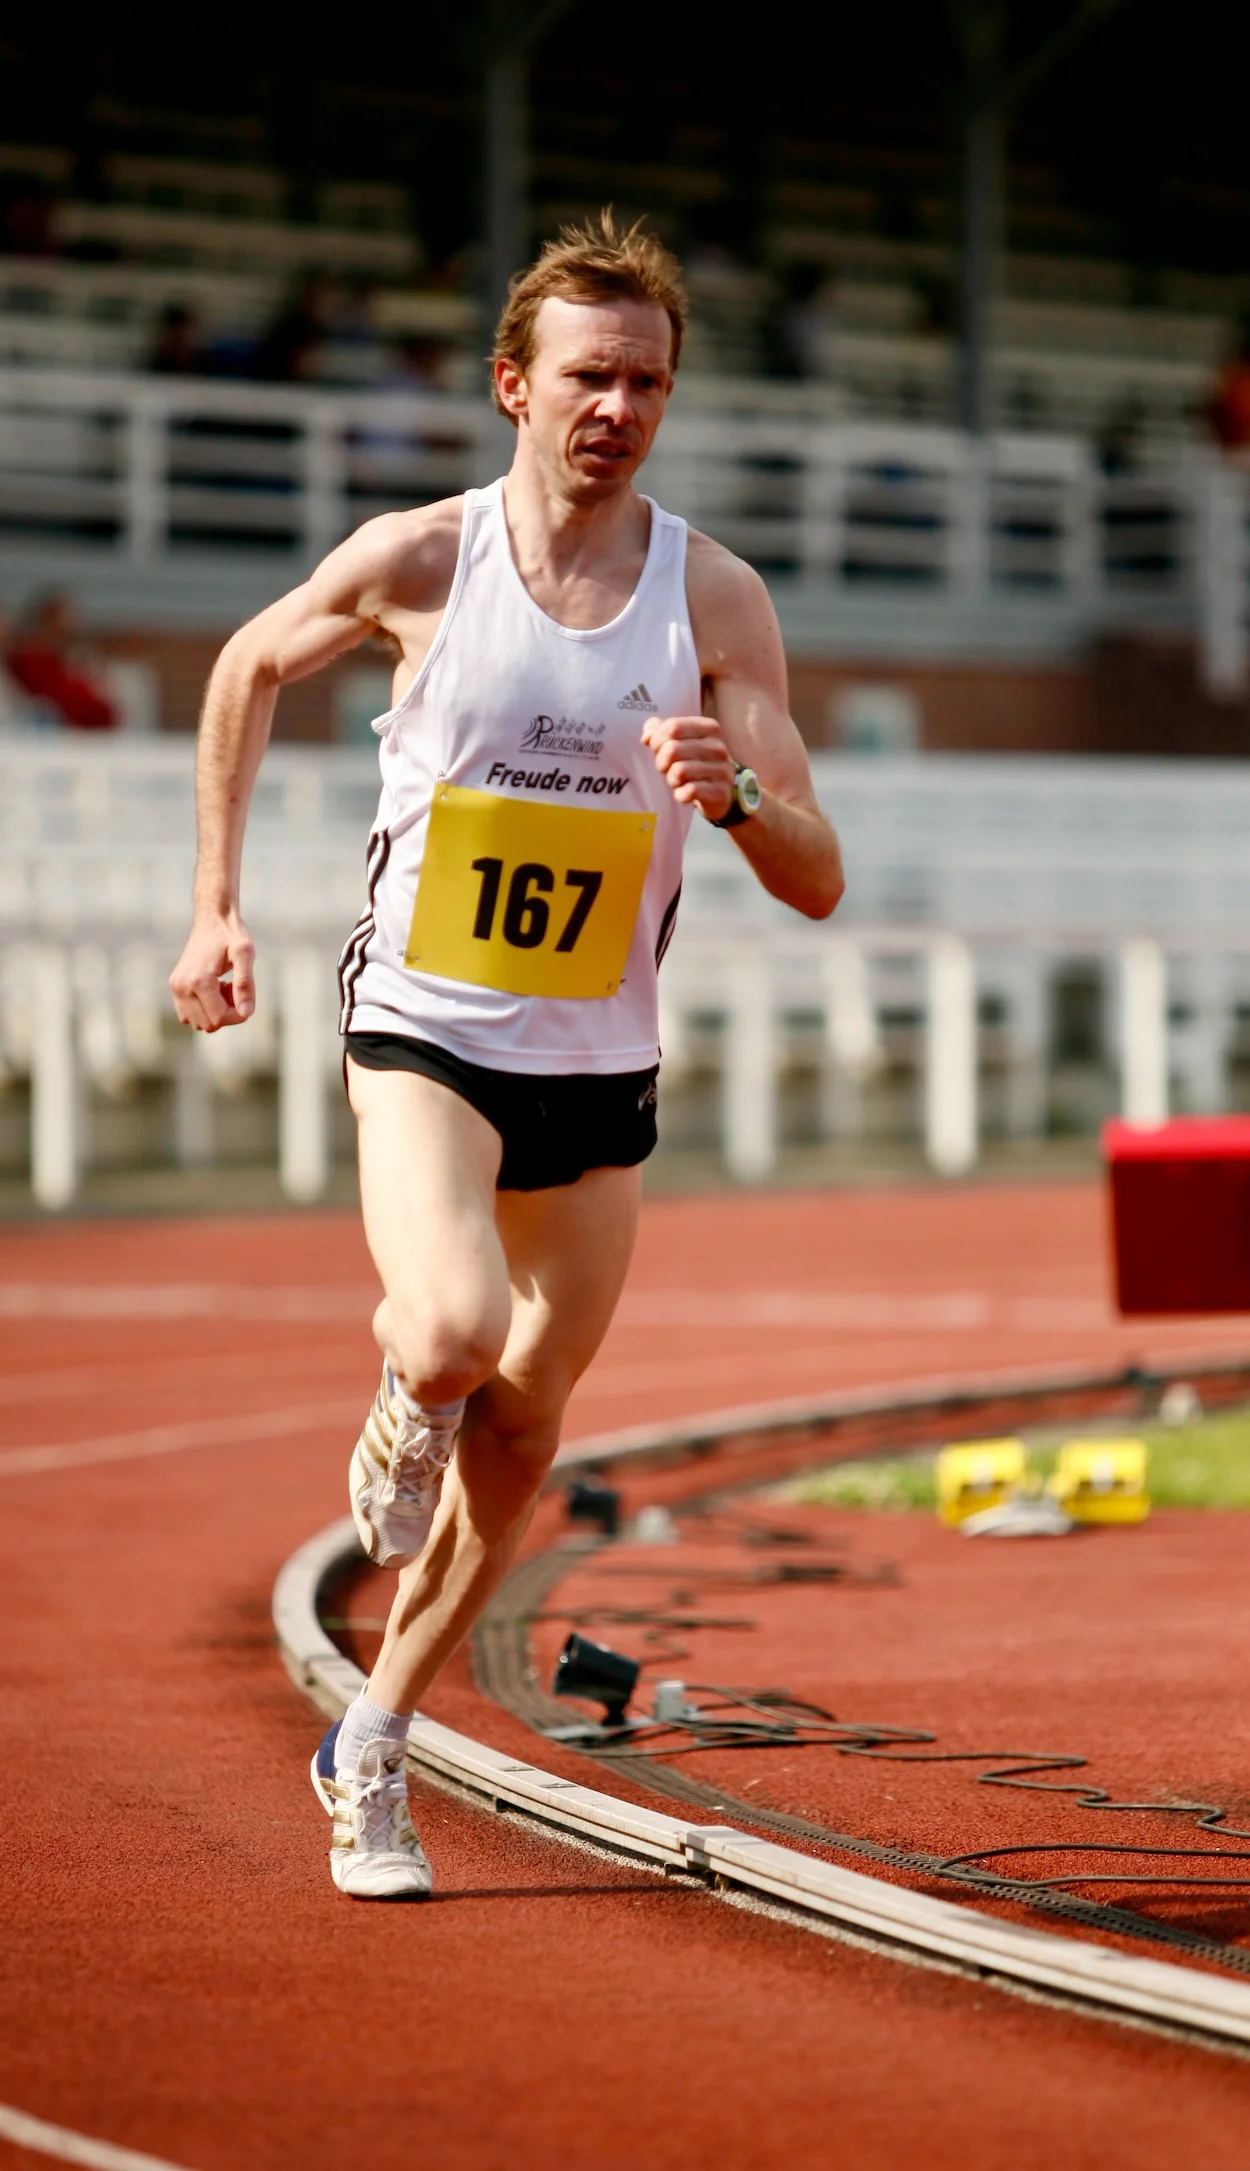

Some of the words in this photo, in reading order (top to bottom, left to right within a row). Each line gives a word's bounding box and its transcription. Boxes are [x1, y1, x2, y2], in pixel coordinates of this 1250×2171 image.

[616, 699, 659, 712] adidas
[485, 762, 571, 791] Freude
[575, 775, 630, 794] now
[471, 857, 603, 953] 167
